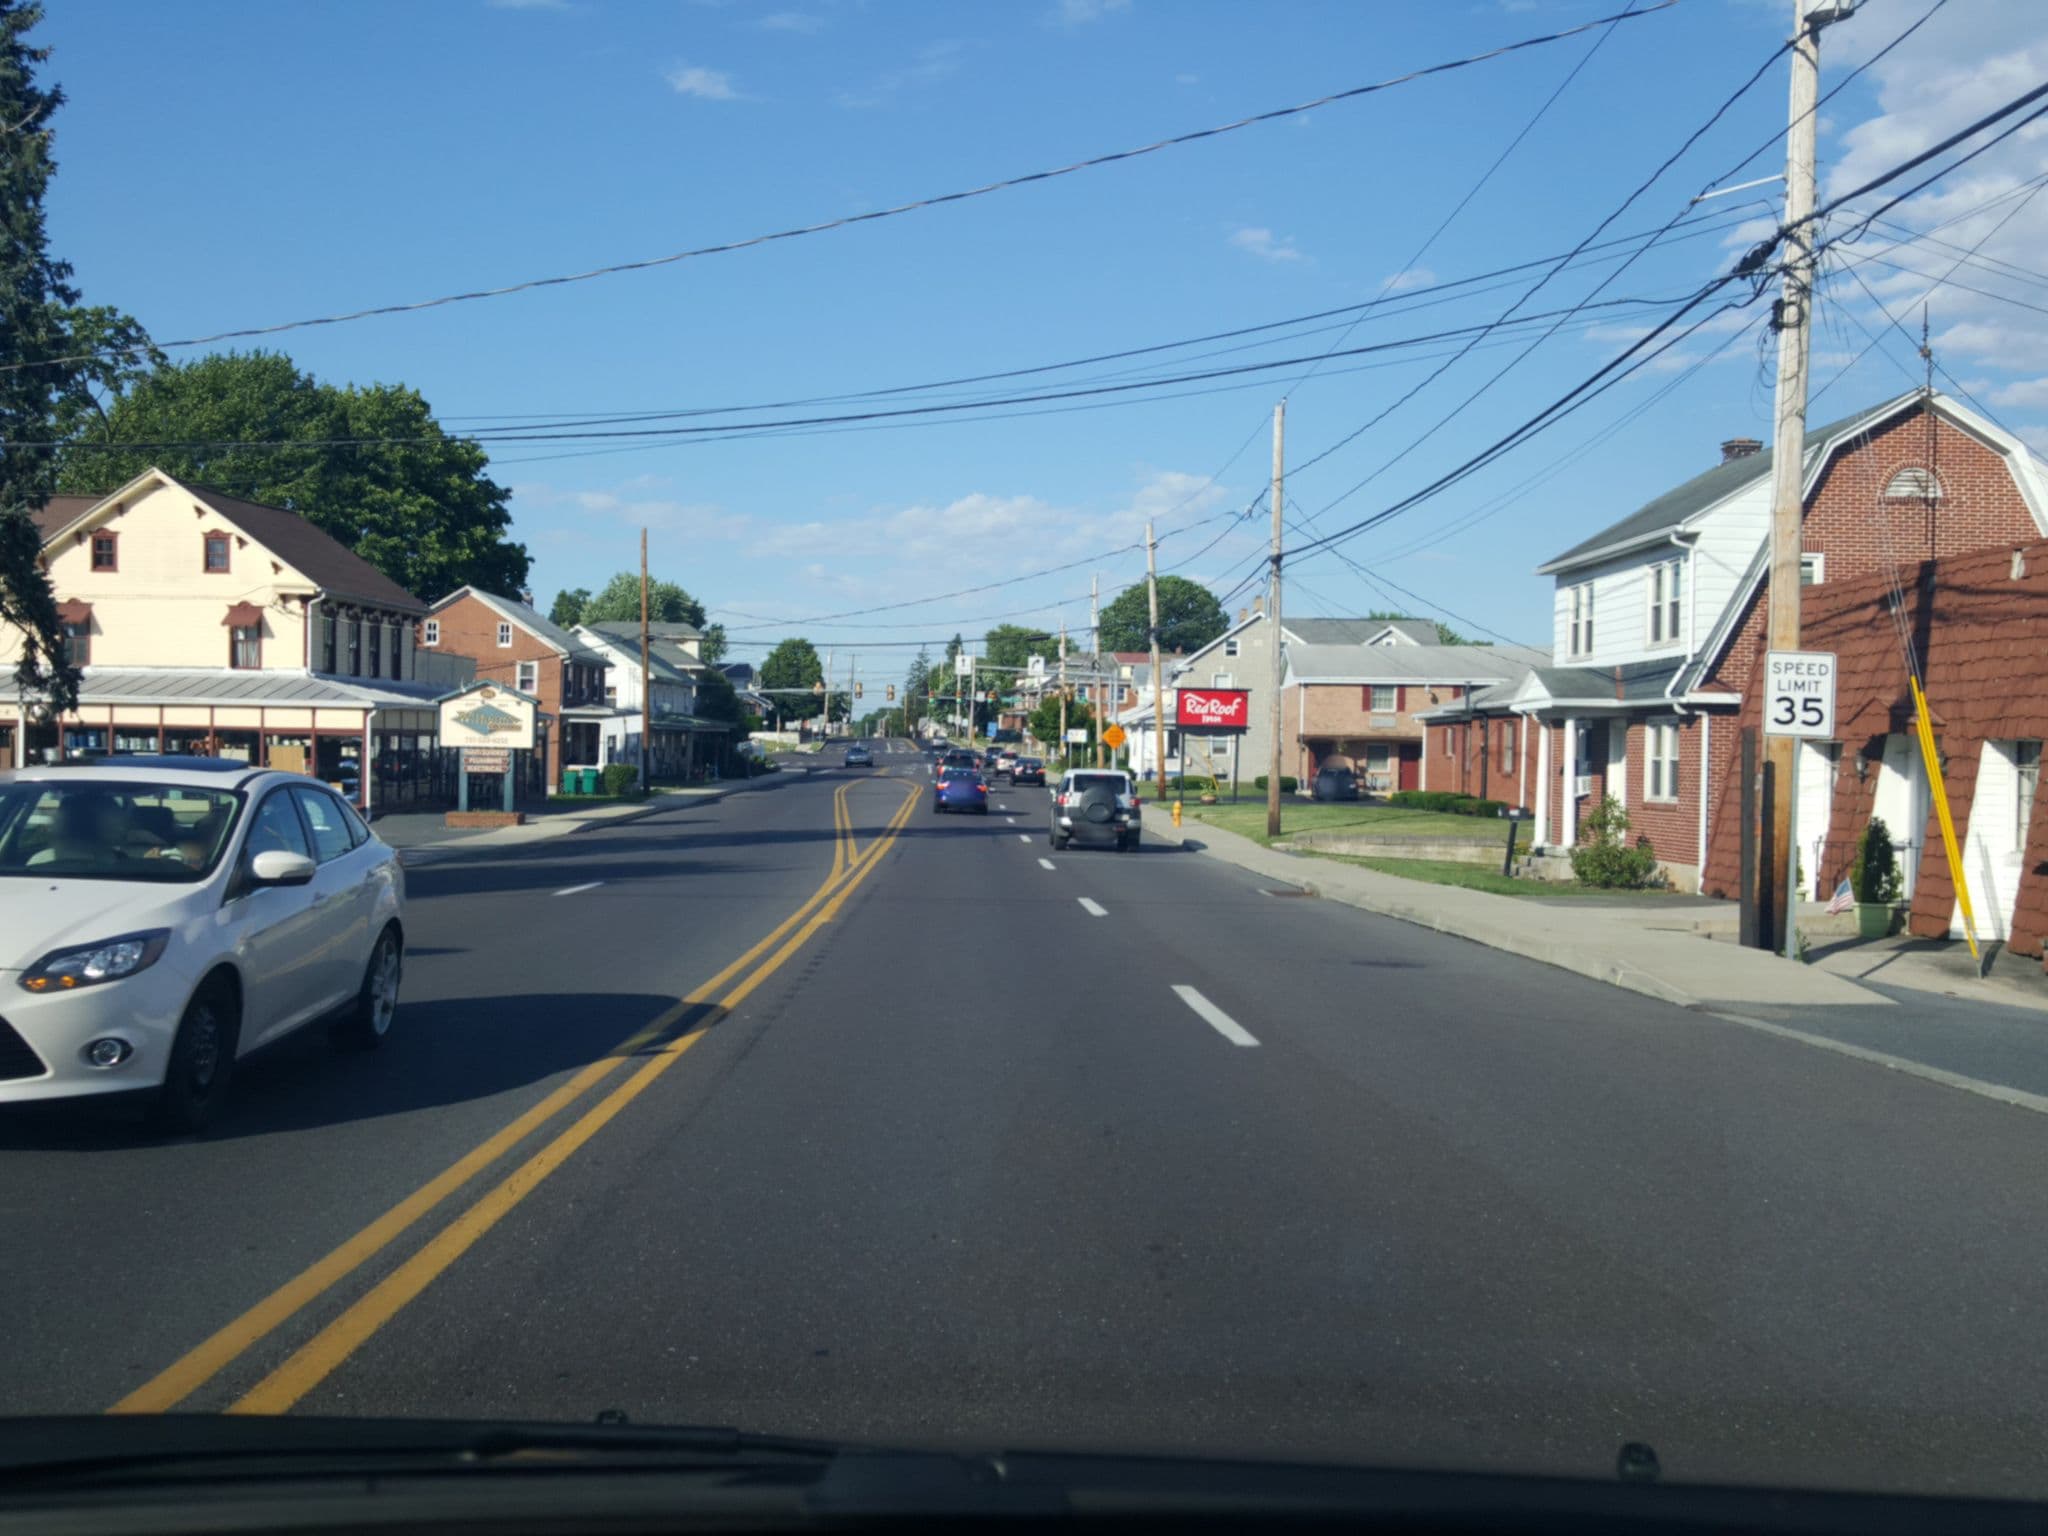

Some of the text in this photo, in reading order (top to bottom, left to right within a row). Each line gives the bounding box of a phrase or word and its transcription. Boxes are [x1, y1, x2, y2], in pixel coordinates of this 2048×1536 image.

[1772, 662, 1829, 676] SPEED
[1777, 680, 1821, 693] LIMIT
[1186, 698, 1242, 717] Red Roof
[1773, 696, 1824, 727] 35
